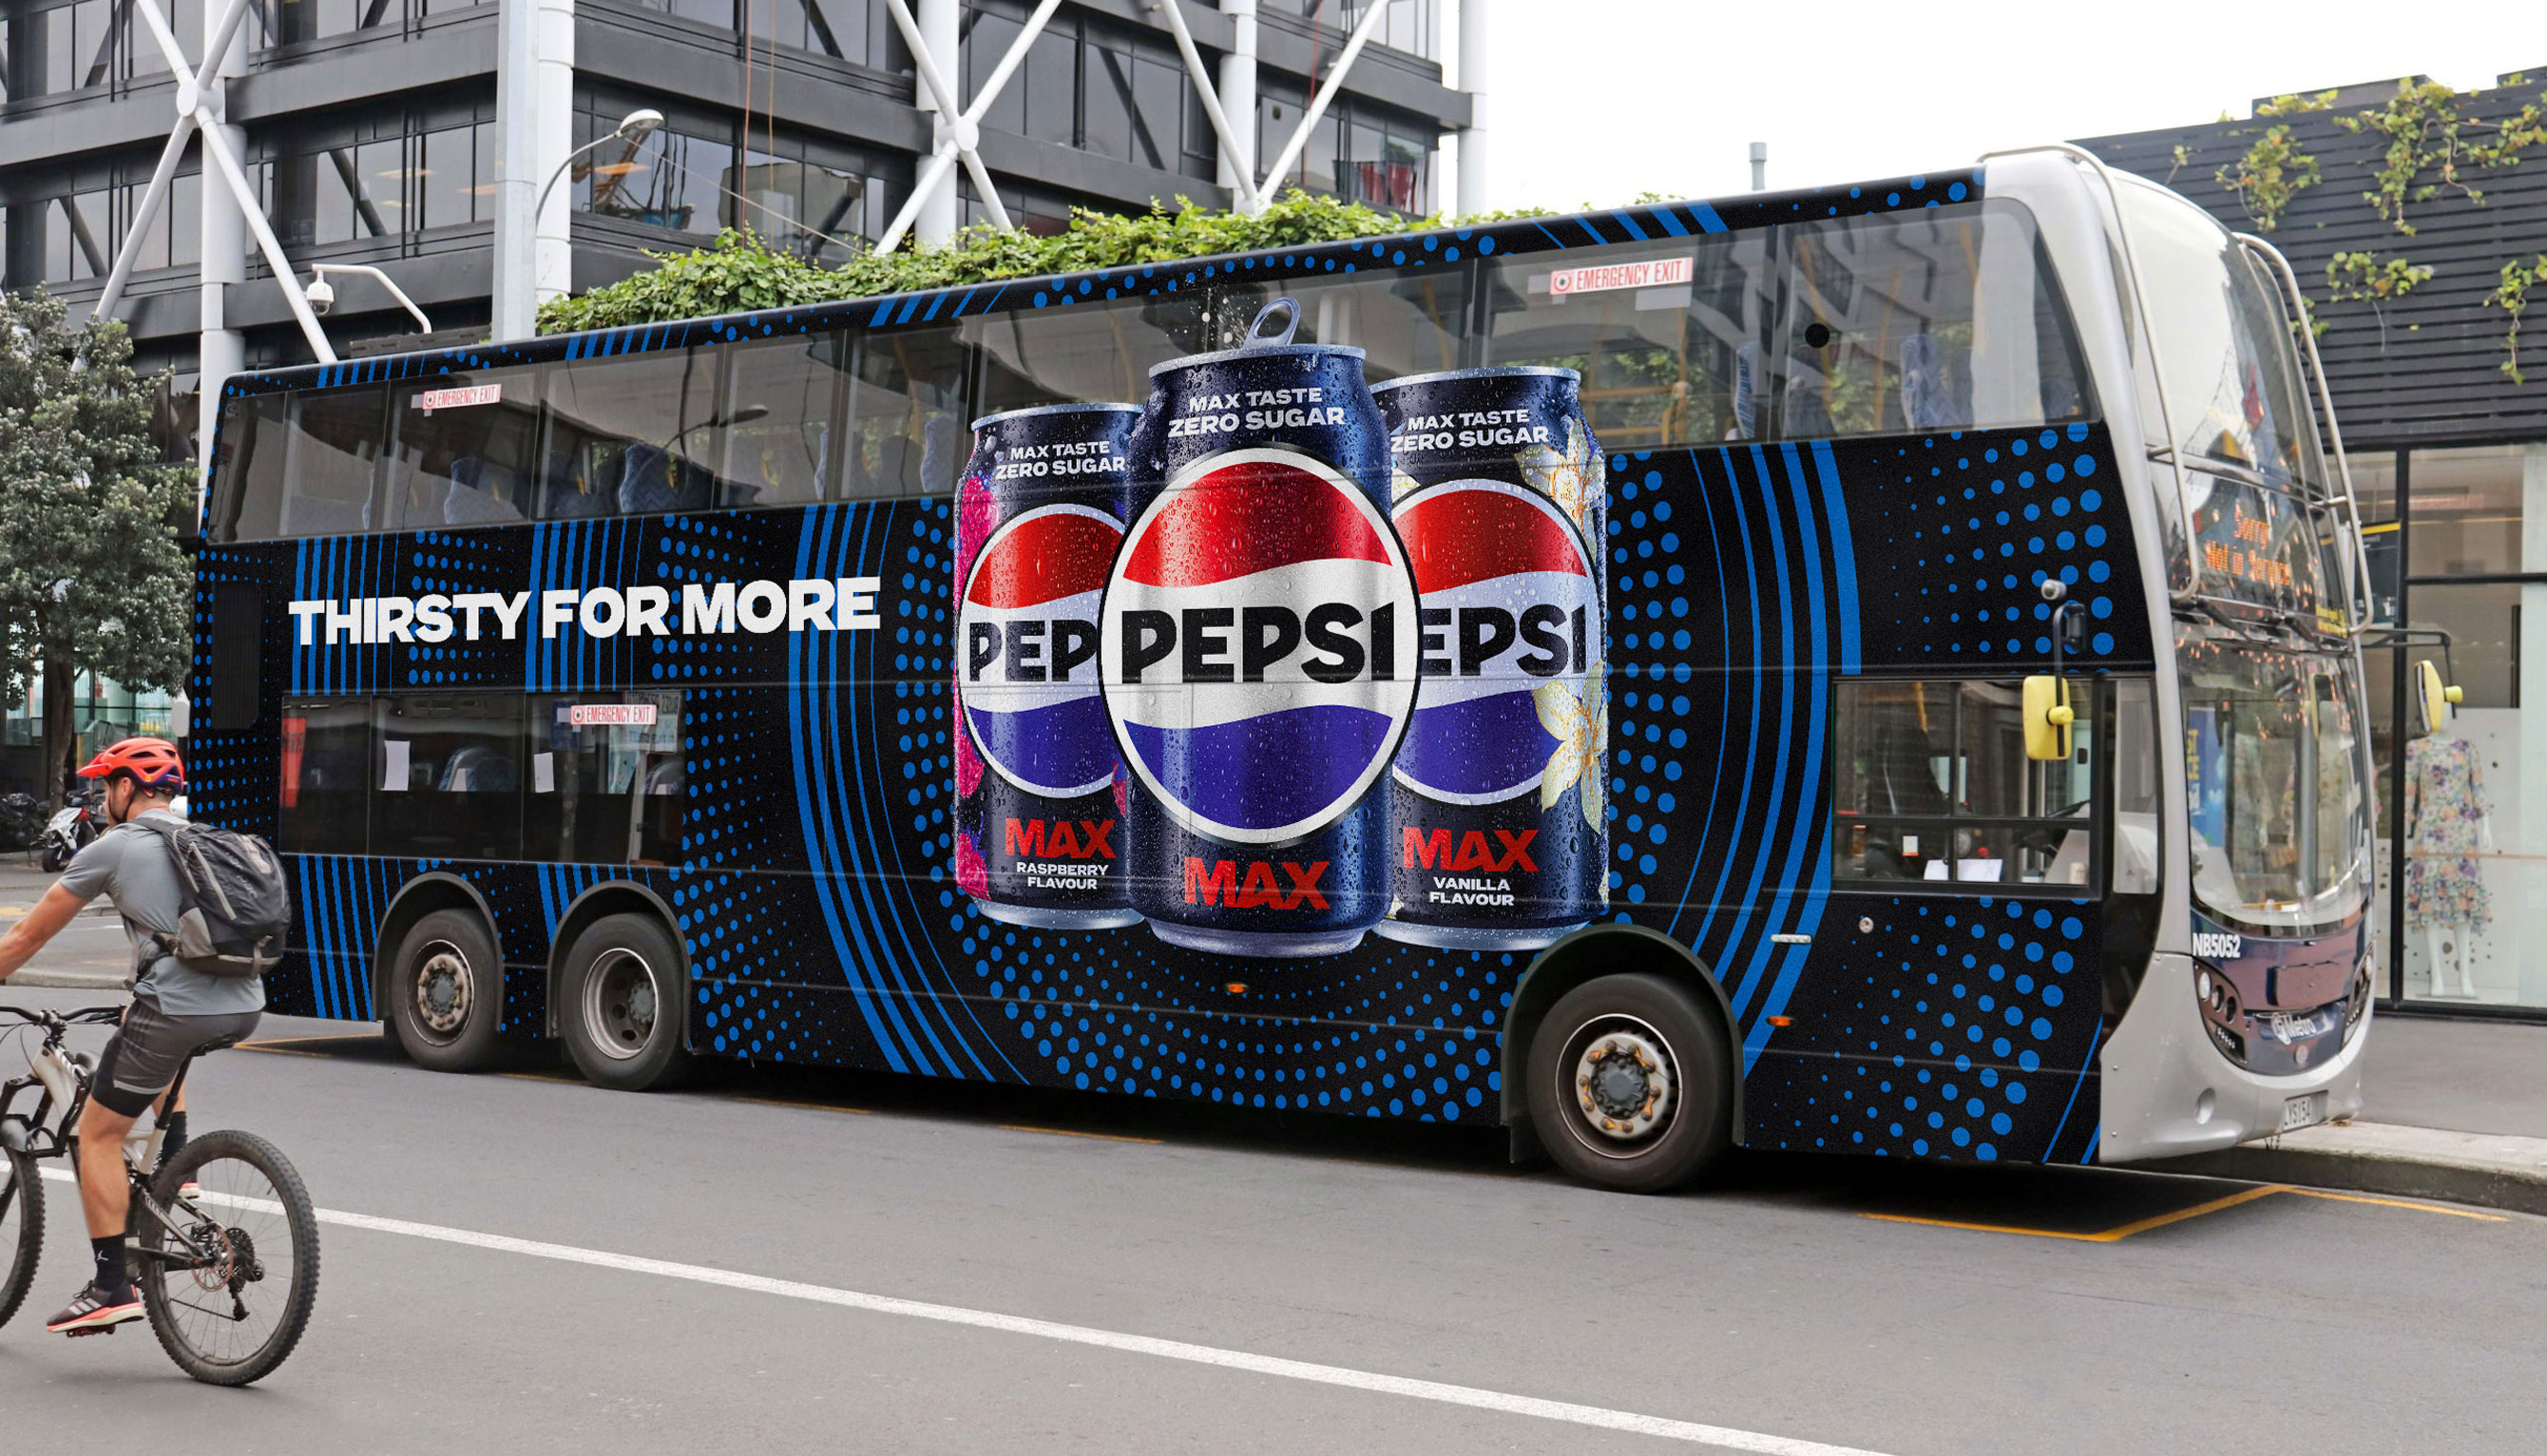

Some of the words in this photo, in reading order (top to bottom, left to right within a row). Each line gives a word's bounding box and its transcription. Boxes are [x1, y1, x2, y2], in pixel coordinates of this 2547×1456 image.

[1577, 263, 1651, 290] EMERGENCY
[1655, 259, 1682, 282] EXIT
[437, 388, 478, 407] EMERGENCY
[480, 386, 495, 402] EXIT
[1188, 393, 1241, 412] MAX
[1247, 387, 1324, 406] TASTE
[1168, 412, 1239, 438] ZERO
[1245, 407, 1346, 431] SUGAR
[1408, 414, 1455, 431] MAX
[1459, 410, 1530, 427] TASTE
[1010, 444, 1048, 461] MAX
[1052, 440, 1110, 456] TASTE
[1390, 431, 1454, 452] ZERO
[1459, 426, 1549, 448] SUGAR
[996, 462, 1047, 480] ZERO
[1052, 456, 1126, 476] SUGAR
[2233, 503, 2269, 550] Sorry
[2205, 539, 2230, 573] Not
[288, 591, 532, 646] THIRSTY
[543, 585, 669, 640] FOR
[683, 576, 881, 635] MORE
[969, 619, 1098, 682] PEP
[1121, 602, 1395, 684] PEPSI
[1423, 603, 1586, 678] EPSI
[586, 706, 631, 723] EMERGENCY
[633, 706, 651, 723] EXIT
[1005, 817, 1117, 859] MAX
[1403, 826, 1541, 872] MAX
[1016, 861, 1109, 876] RASPBERRY
[1027, 876, 1098, 890] FLAVOUR
[1185, 856, 1331, 910] MAX
[1433, 876, 1510, 891] VANILLA
[1429, 891, 1515, 907] FLAVOUR
[2192, 932, 2241, 958] NB5052
[2283, 1013, 2317, 1038] Metro
